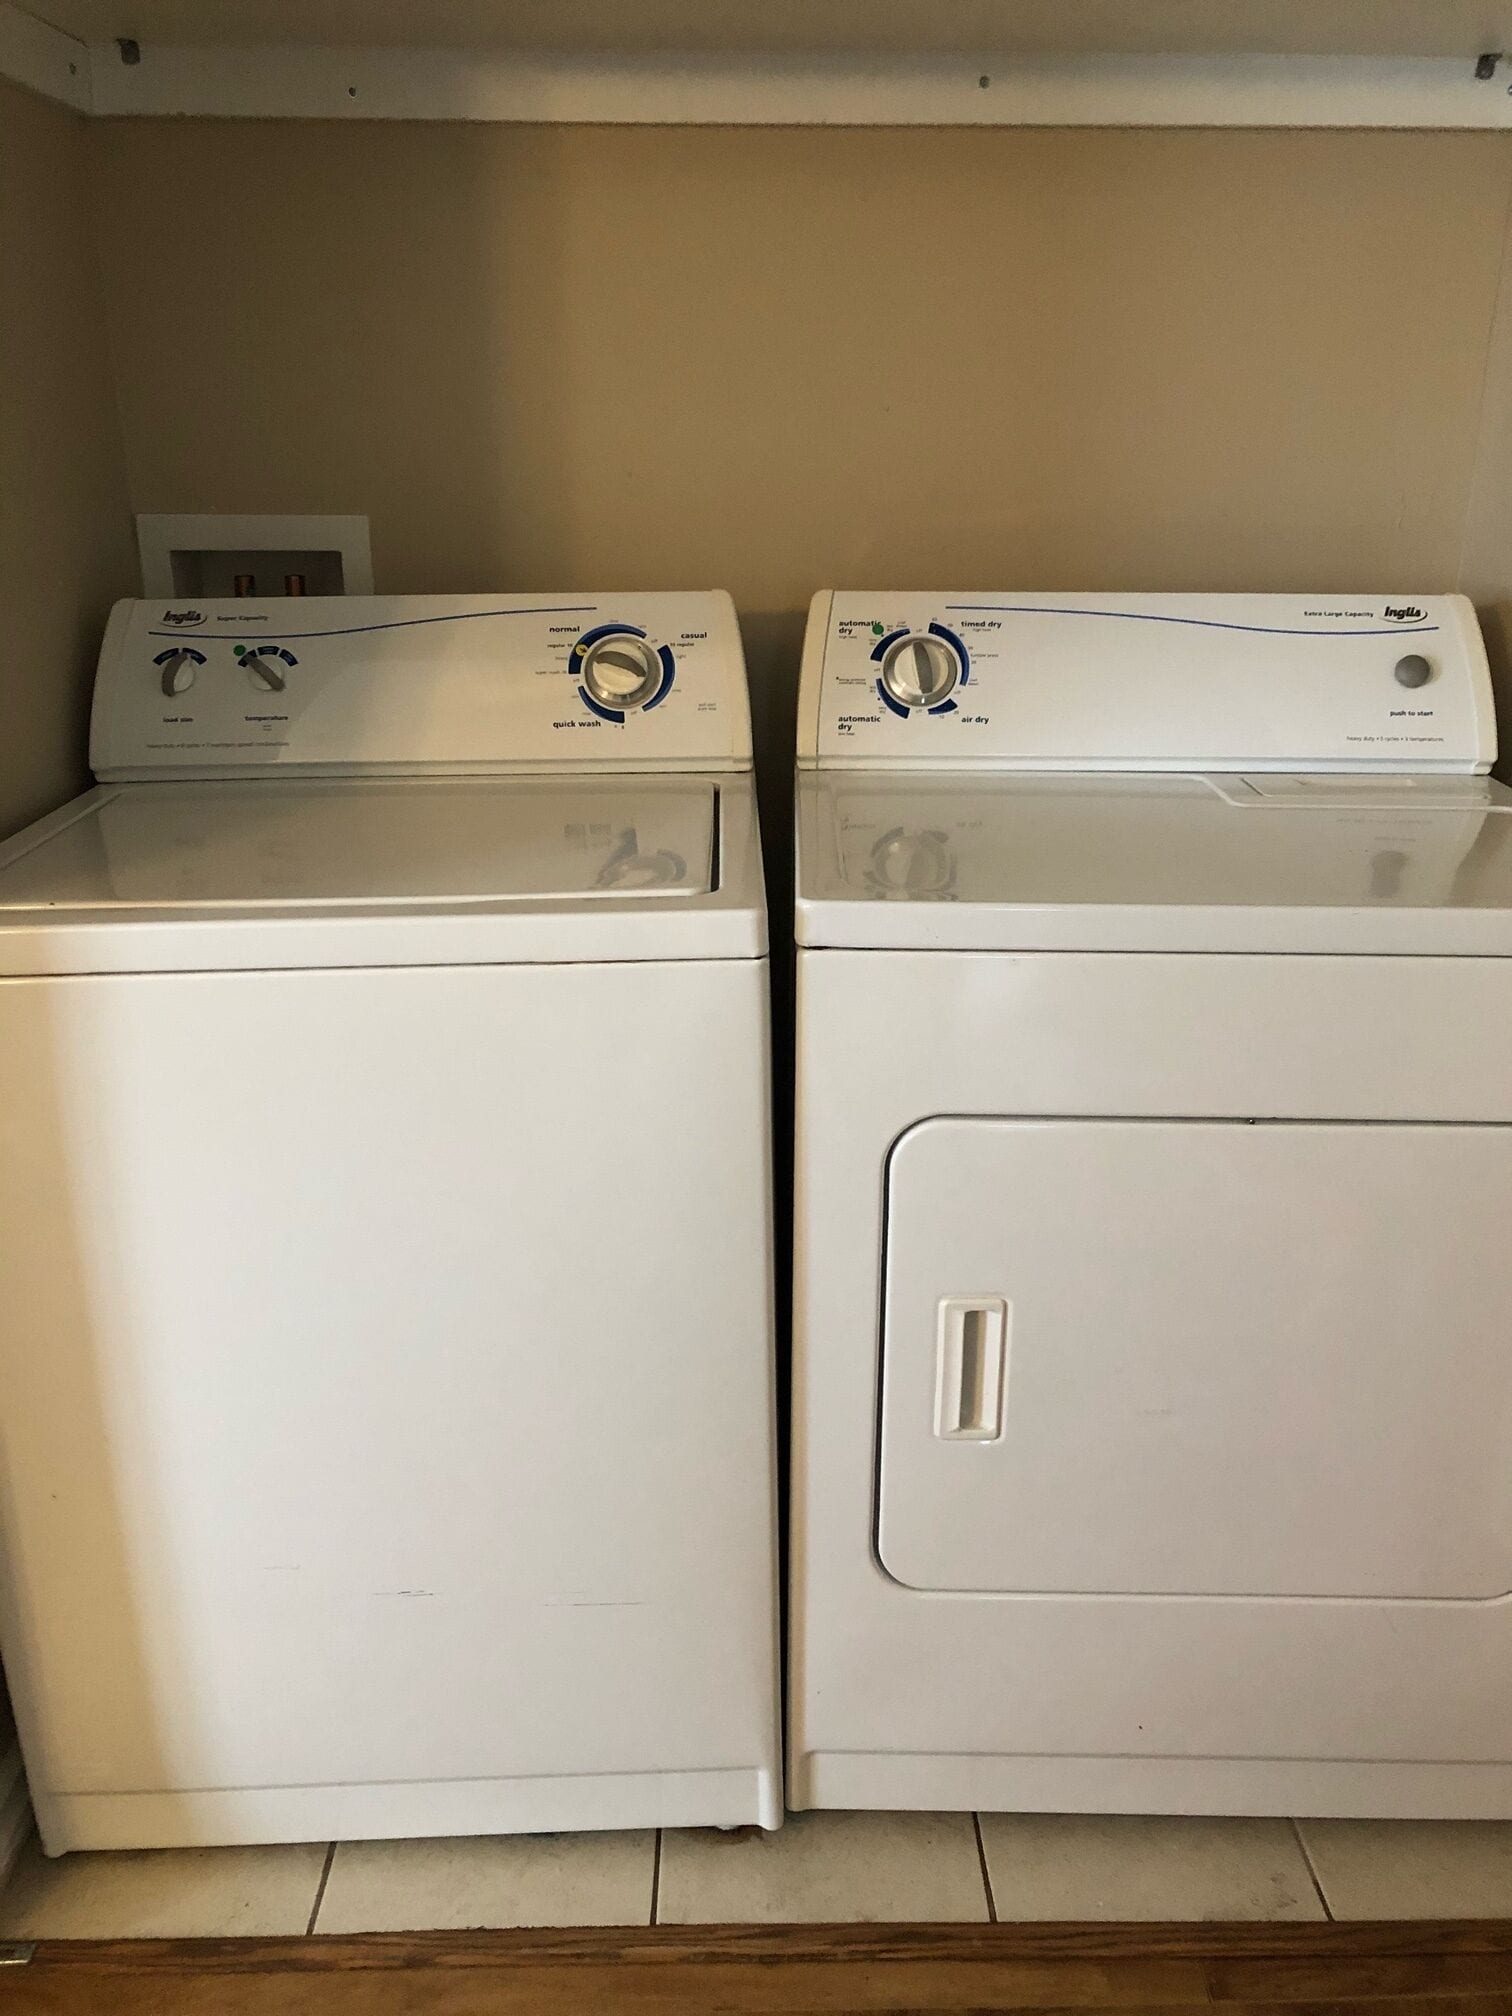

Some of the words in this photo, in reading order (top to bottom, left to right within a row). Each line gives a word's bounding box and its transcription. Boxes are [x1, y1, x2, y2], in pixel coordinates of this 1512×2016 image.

[163, 610, 201, 624] Inglis
[1384, 605, 1421, 620] Inglis
[549, 625, 580, 633] normal
[961, 620, 984, 628] timed
[985, 620, 1002, 629] dry
[680, 631, 708, 639] casual
[838, 627, 853, 635] dry
[552, 720, 577, 729] quick
[578, 719, 602, 728] wash
[974, 716, 990, 724] dry
[838, 723, 852, 732] dry
